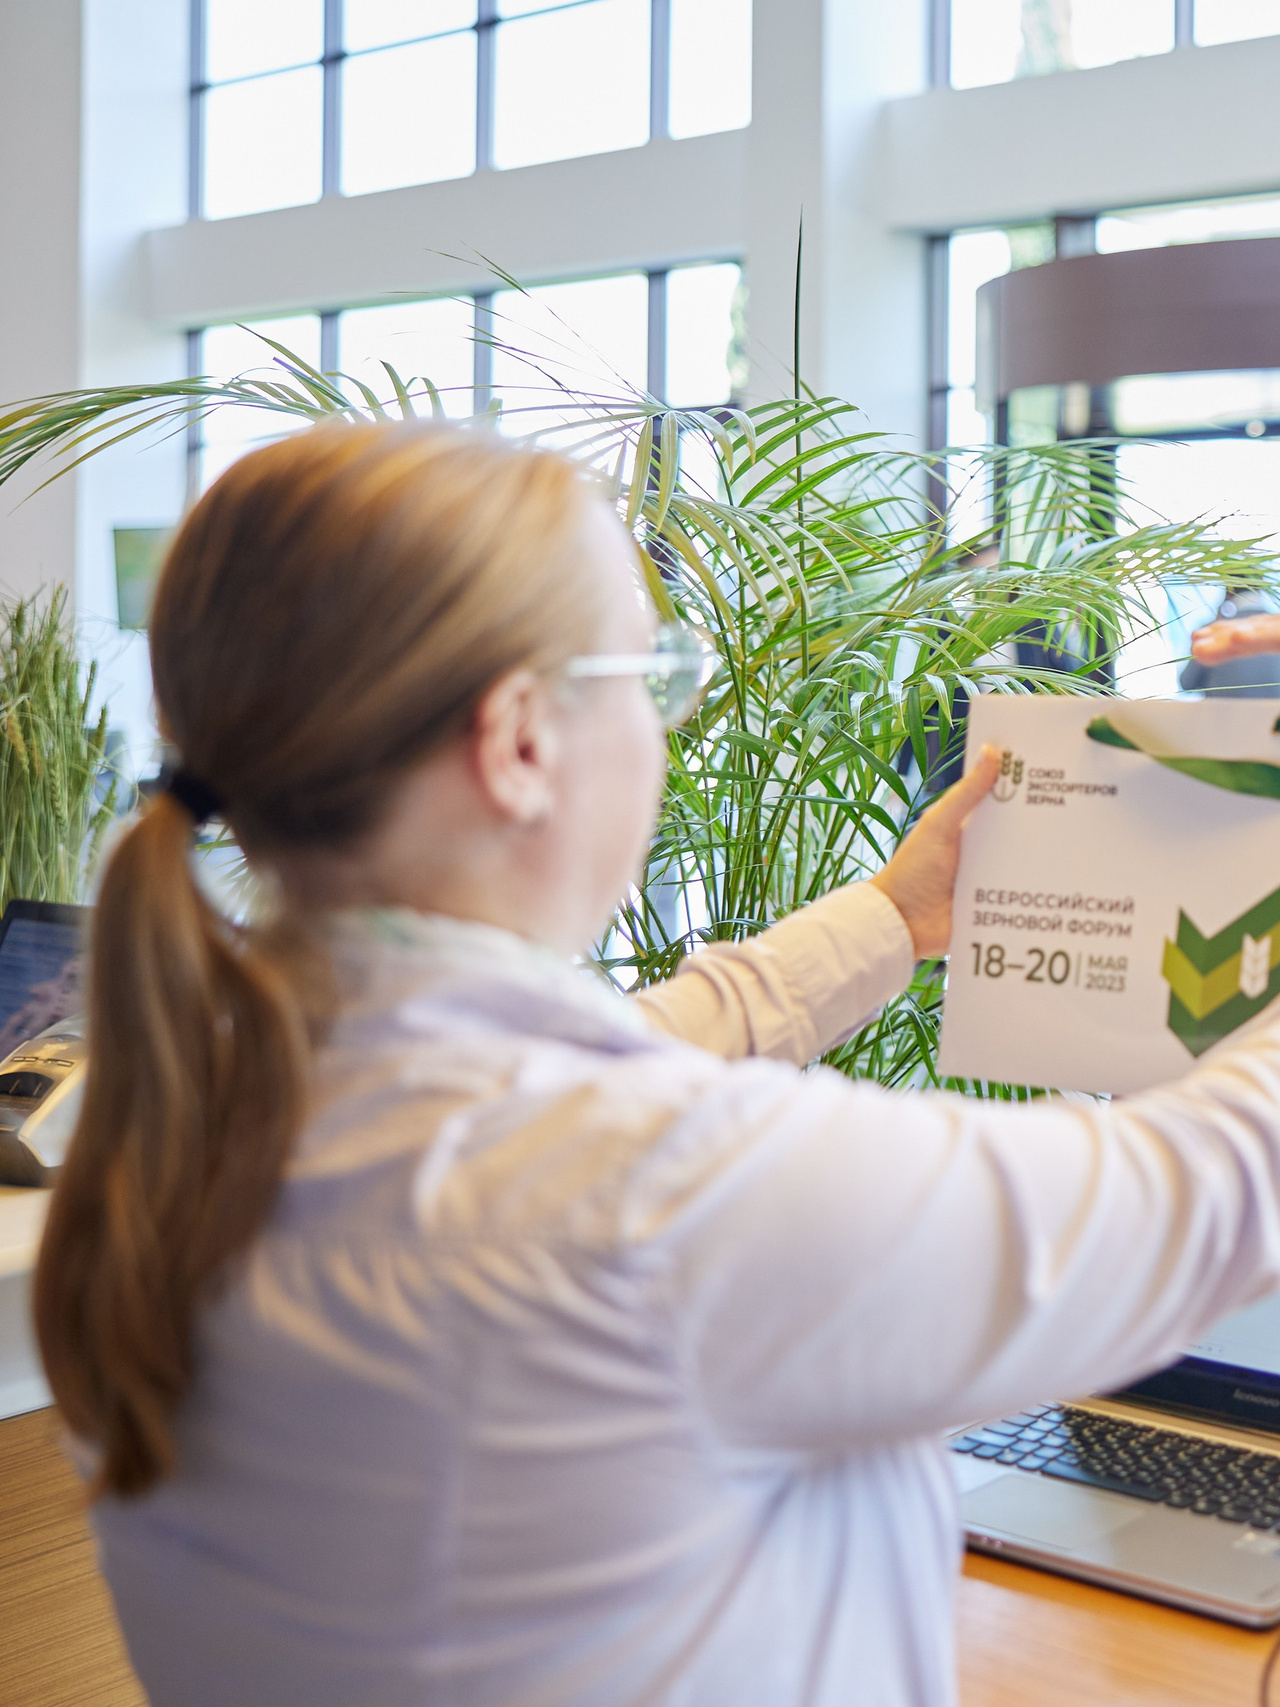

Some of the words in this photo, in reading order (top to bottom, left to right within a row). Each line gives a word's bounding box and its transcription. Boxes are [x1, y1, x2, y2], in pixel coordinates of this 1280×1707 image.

[1027, 768, 1065, 780] СОЮЗ
[1027, 781, 1118, 796] ЭКСПОРТЕРОВ
[1025, 794, 1066, 806] ЗЕРНА
[975, 888, 1135, 915] ВСЕРОССИЙСКИЙ
[972, 909, 1063, 932] ЗЕРНОВОЙ
[1067, 918, 1133, 938] ФОРУМ
[1087, 954, 1128, 972] МАЯ
[1085, 972, 1126, 991] 2023
